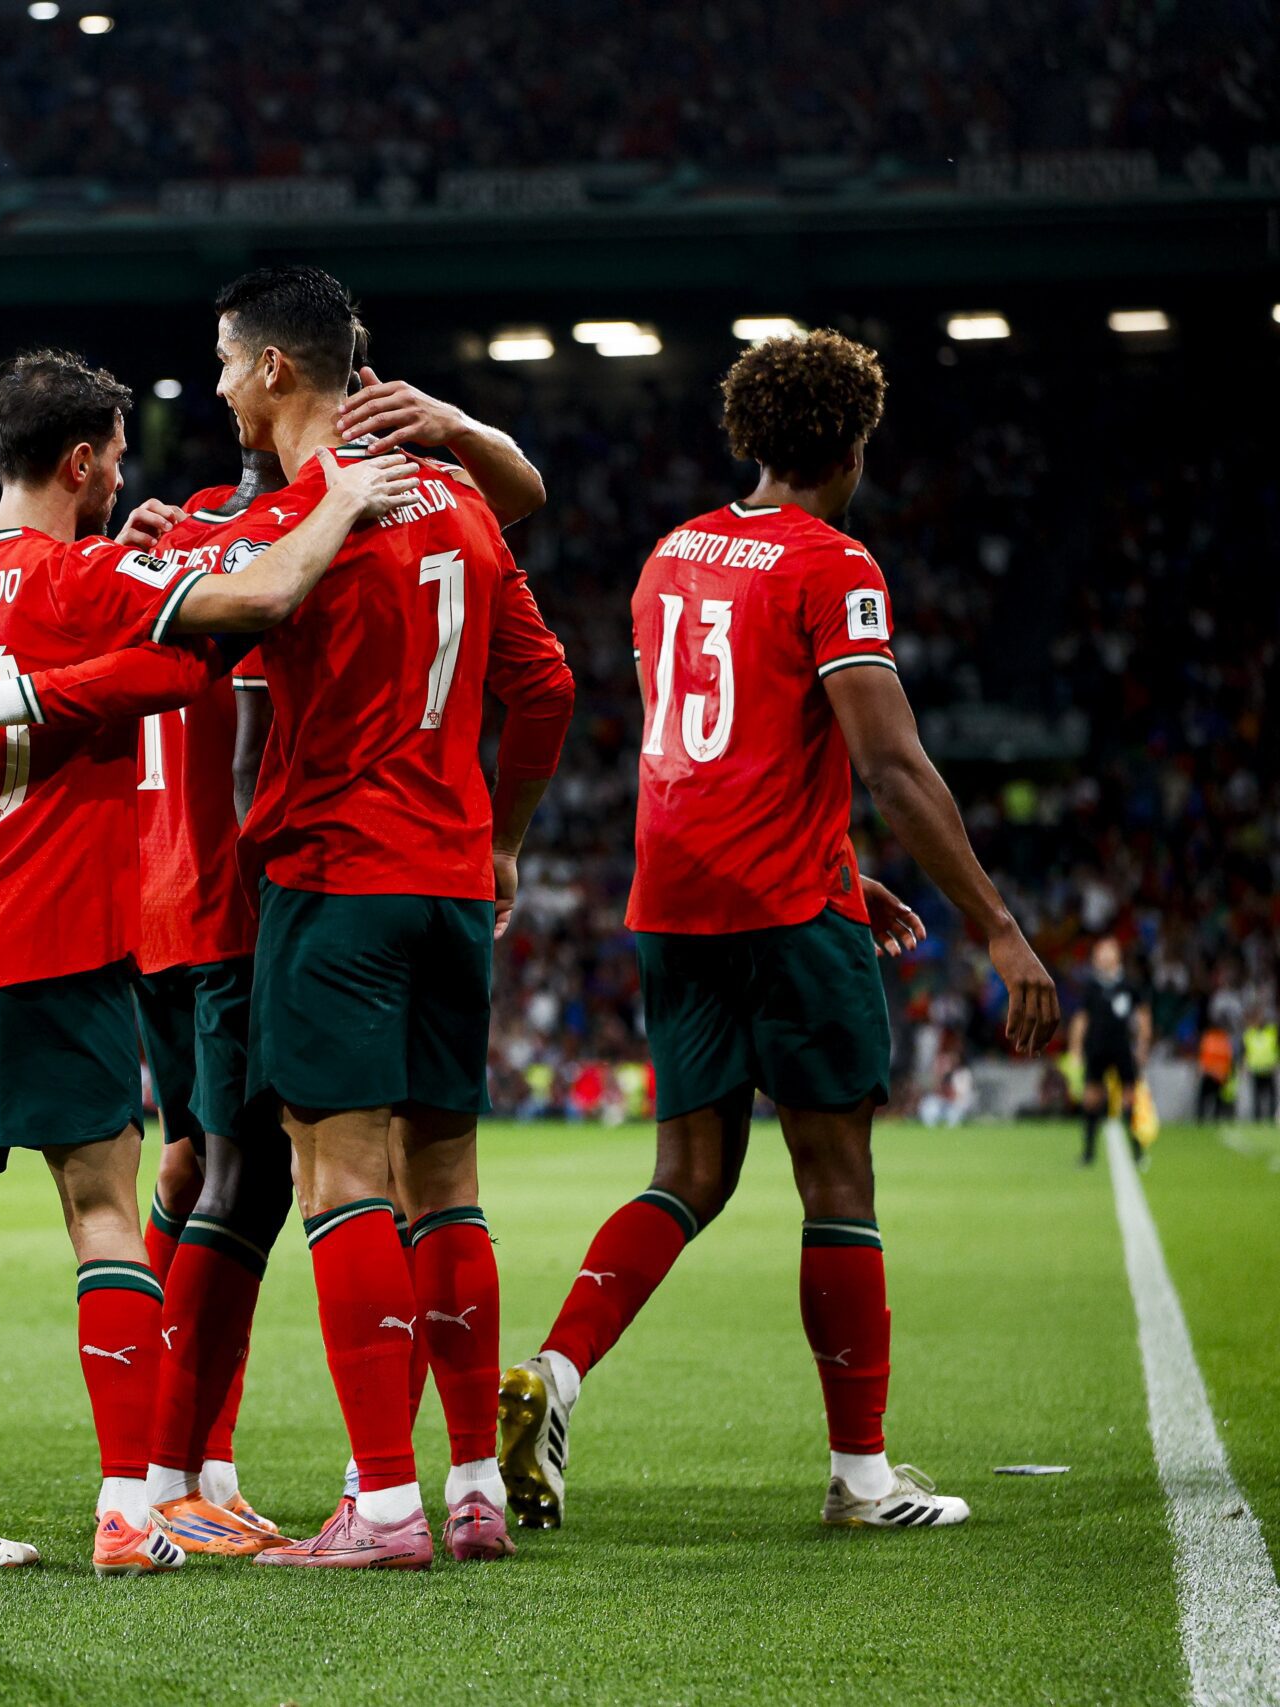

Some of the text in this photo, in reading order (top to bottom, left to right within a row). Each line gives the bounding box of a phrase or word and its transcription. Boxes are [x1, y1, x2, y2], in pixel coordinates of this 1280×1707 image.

[656, 529, 785, 571] RENATO VEIGA
[419, 549, 465, 729] 7
[642, 593, 735, 763] 13
